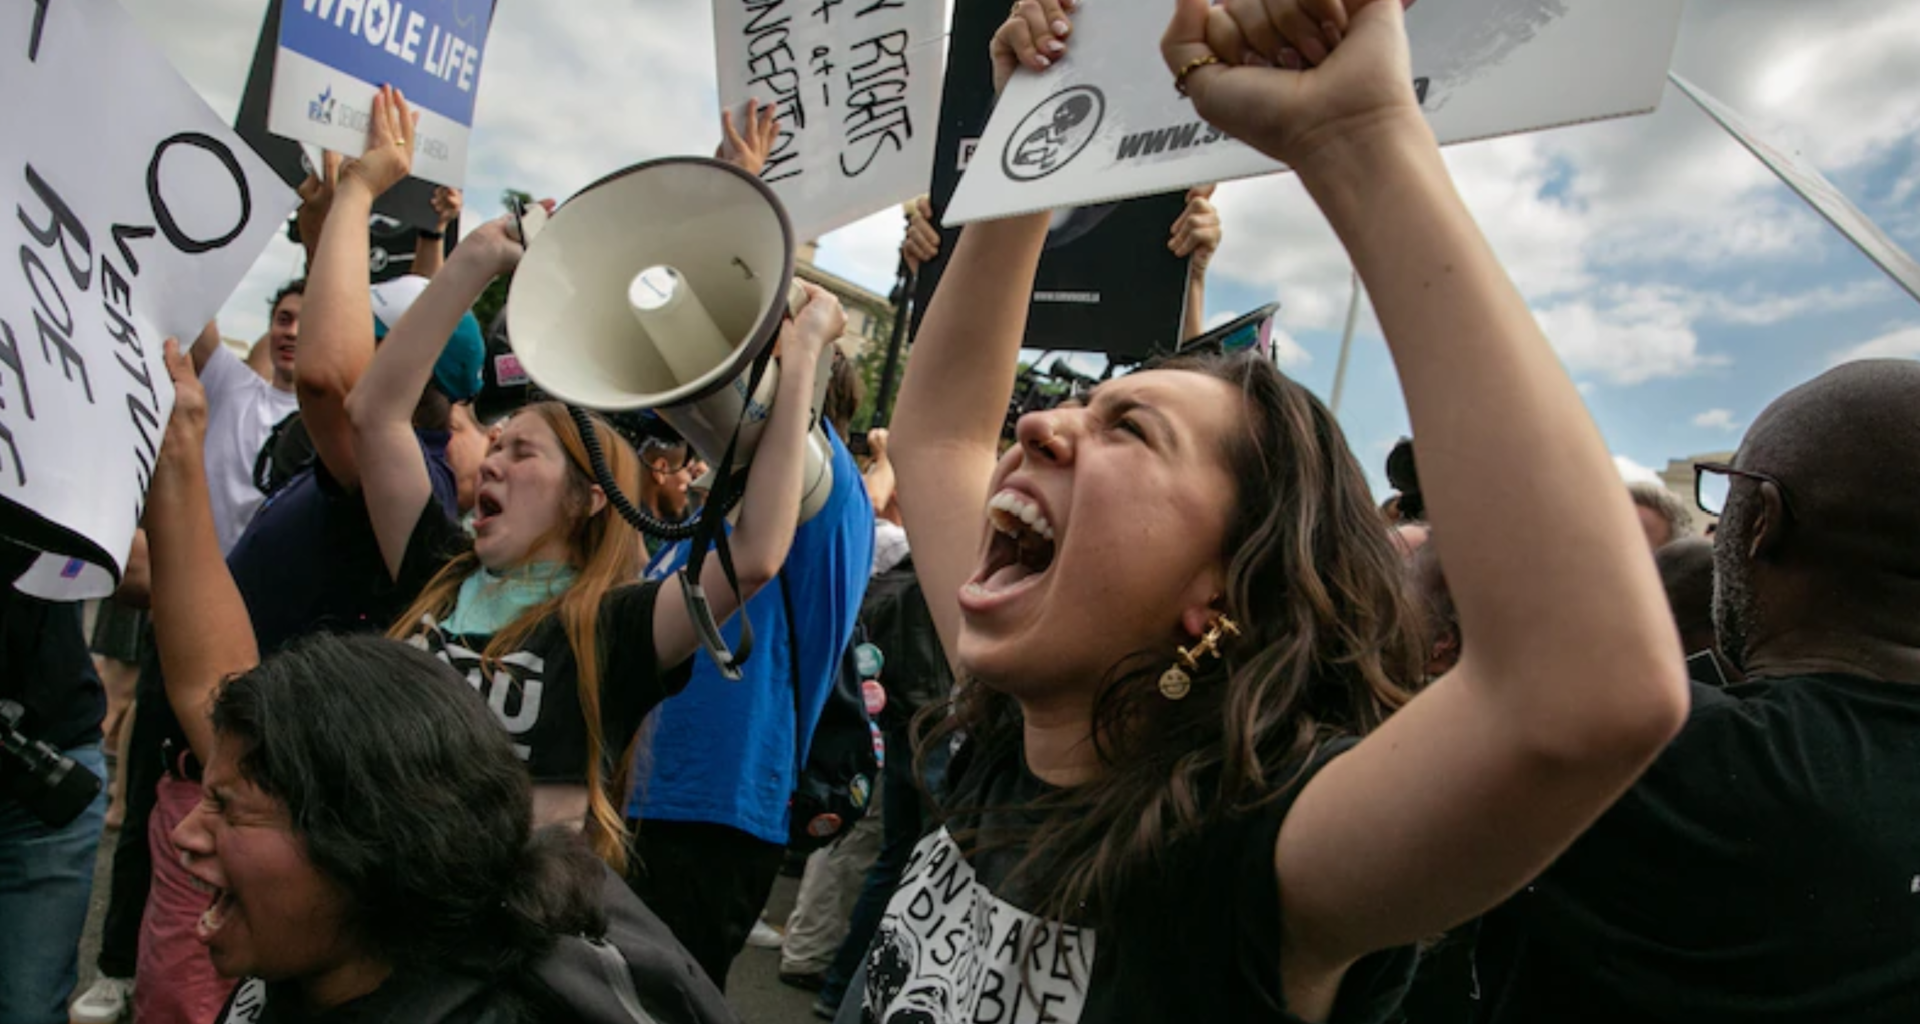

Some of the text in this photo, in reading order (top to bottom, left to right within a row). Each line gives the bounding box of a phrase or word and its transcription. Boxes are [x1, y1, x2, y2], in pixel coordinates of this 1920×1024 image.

[423, 25, 478, 92] LIFE
[839, 29, 912, 178] RIGHTS
[16, 162, 95, 405] ROE
[995, 918, 1079, 979] ARE
